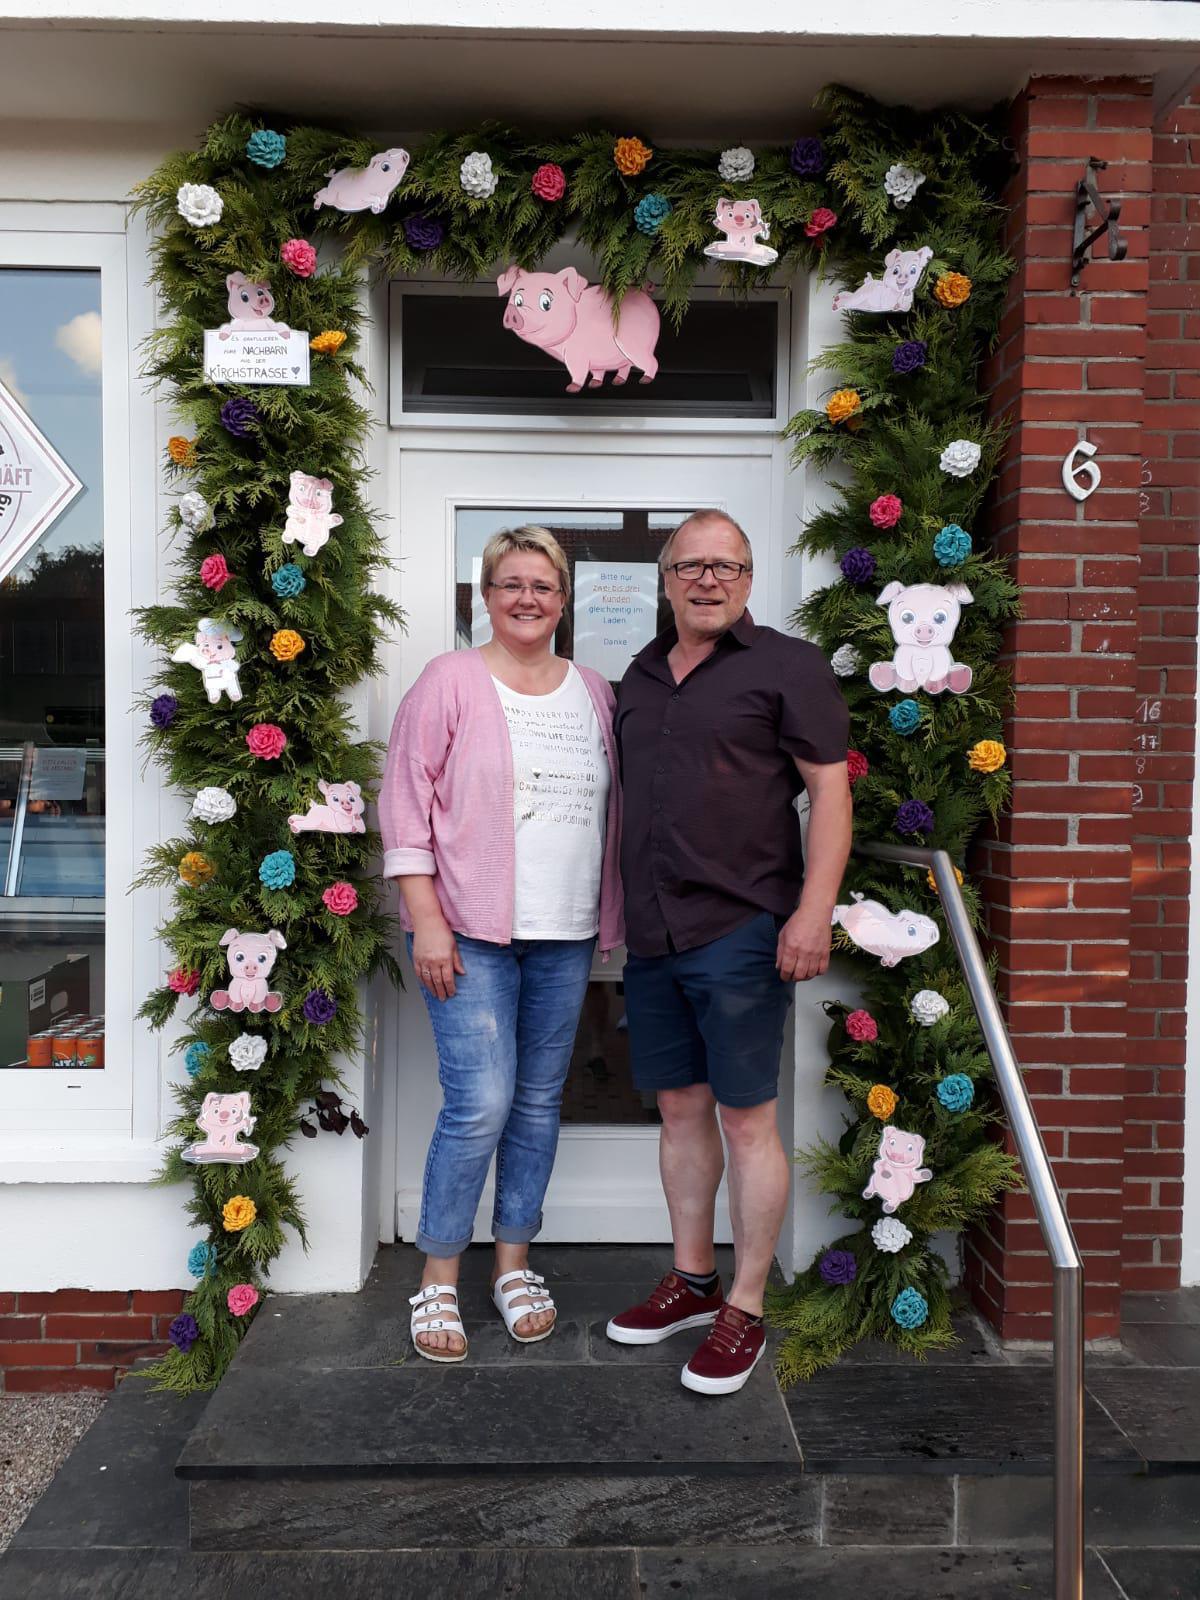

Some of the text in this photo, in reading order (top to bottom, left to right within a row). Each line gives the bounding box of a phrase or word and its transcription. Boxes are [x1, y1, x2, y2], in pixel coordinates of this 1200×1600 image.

[242, 345, 288, 356] NACHBARN
[0, 463, 33, 486] ÄFT
[1062, 440, 1102, 501] 6
[600, 573, 618, 581] Bitte
[602, 595, 631, 603] Kunden
[588, 605, 644, 615] gleichzeitig im
[603, 616, 626, 624] Laden
[603, 638, 628, 646] Danke
[1136, 698, 1161, 723] 16
[536, 711, 561, 719] EVERY
[564, 711, 579, 720] DAY
[548, 733, 563, 741] LIFE
[577, 787, 597, 798] HOW
